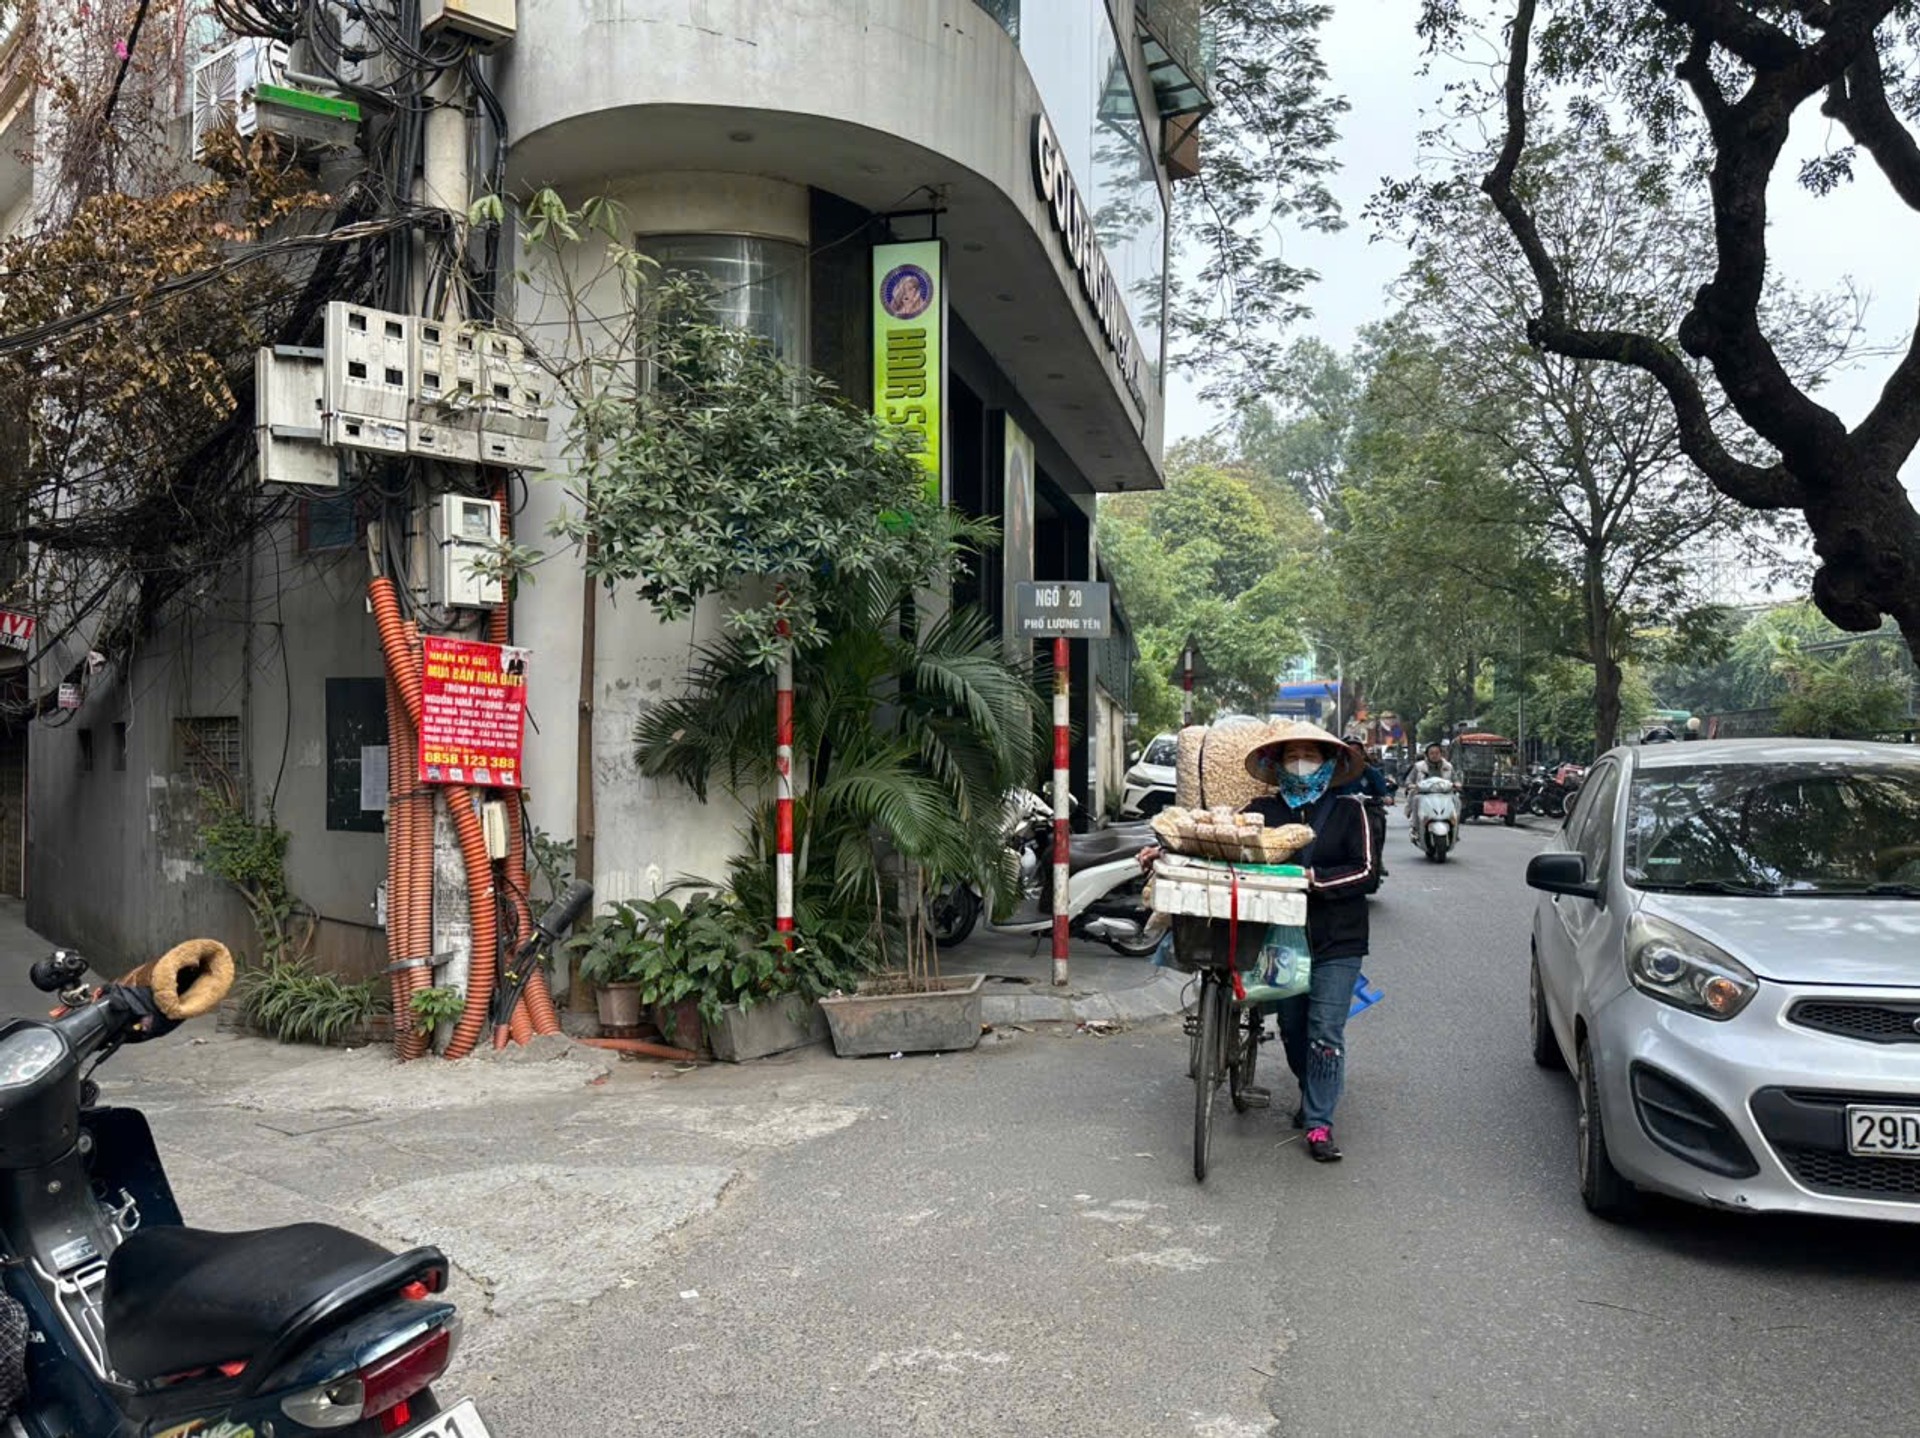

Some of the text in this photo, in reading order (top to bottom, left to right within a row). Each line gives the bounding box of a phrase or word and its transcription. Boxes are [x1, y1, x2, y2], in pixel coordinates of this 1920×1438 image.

[885, 327, 927, 399] HAIR
[1068, 589, 1082, 607] 20
[463, 754, 488, 767] 123
